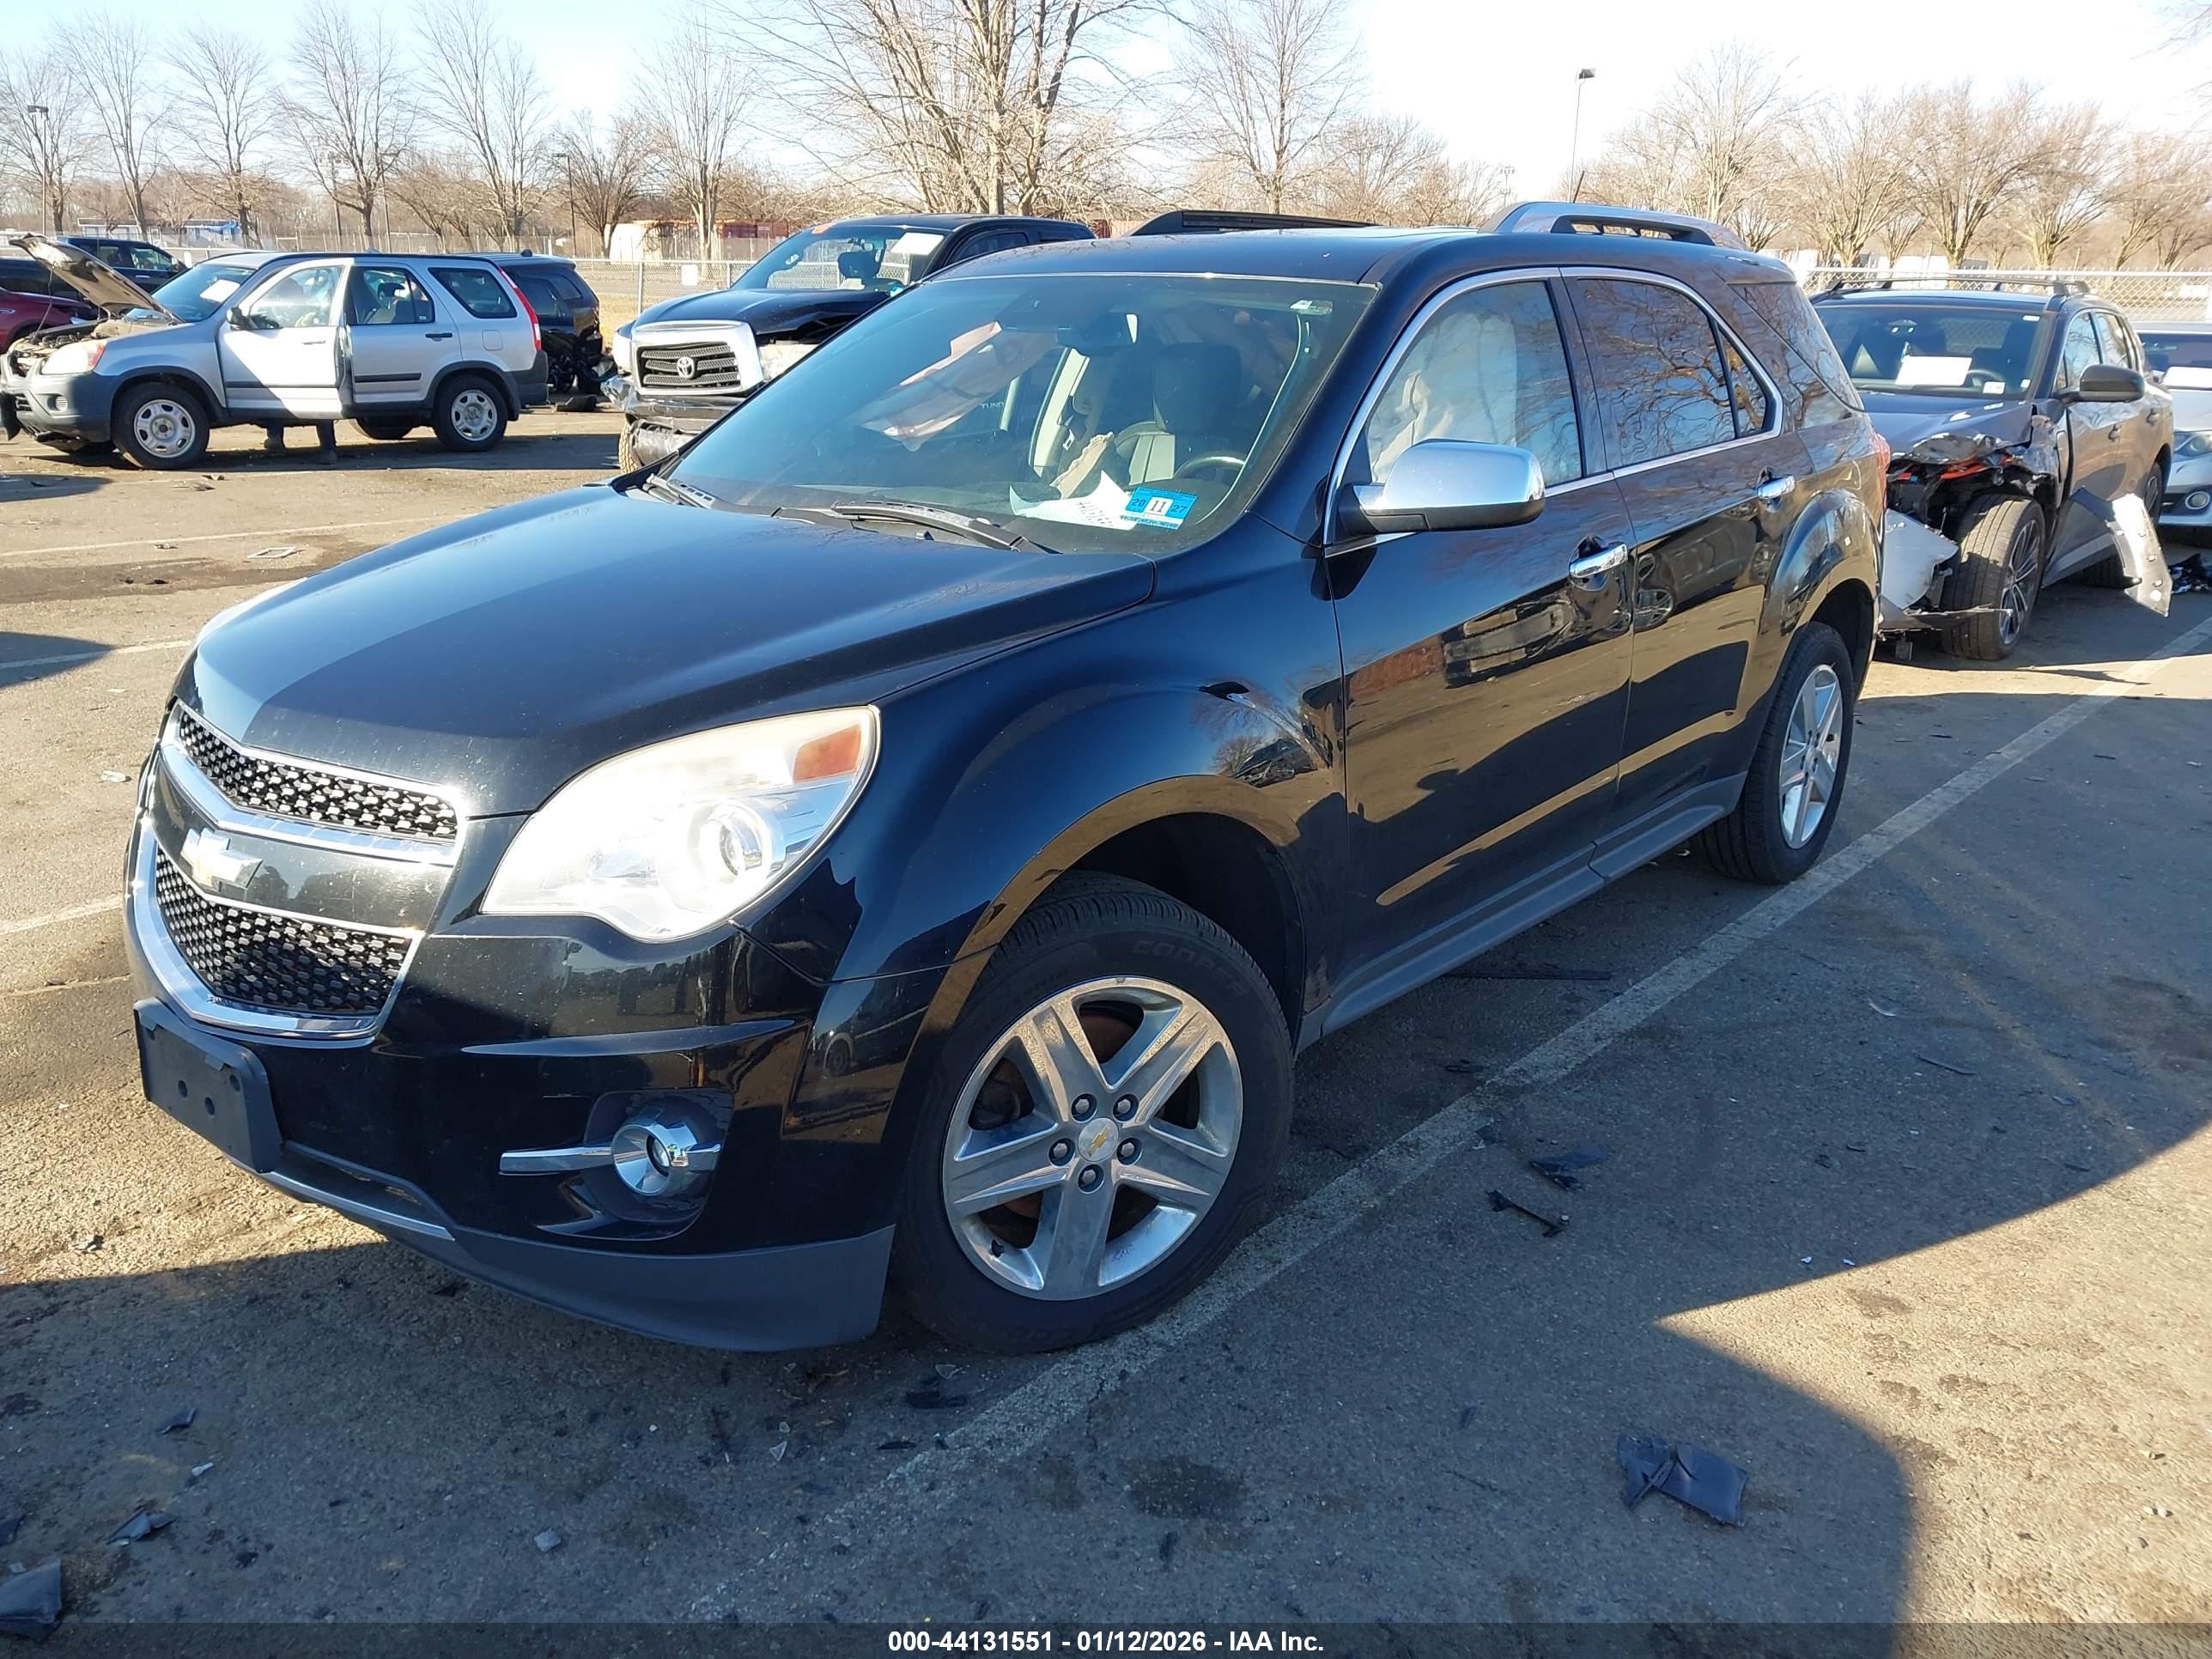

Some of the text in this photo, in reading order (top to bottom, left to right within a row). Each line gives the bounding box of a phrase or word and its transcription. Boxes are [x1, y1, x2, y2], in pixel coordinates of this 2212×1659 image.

[1131, 498, 1187, 514] 20 11 27
[1133, 939, 1250, 996] COOPER
